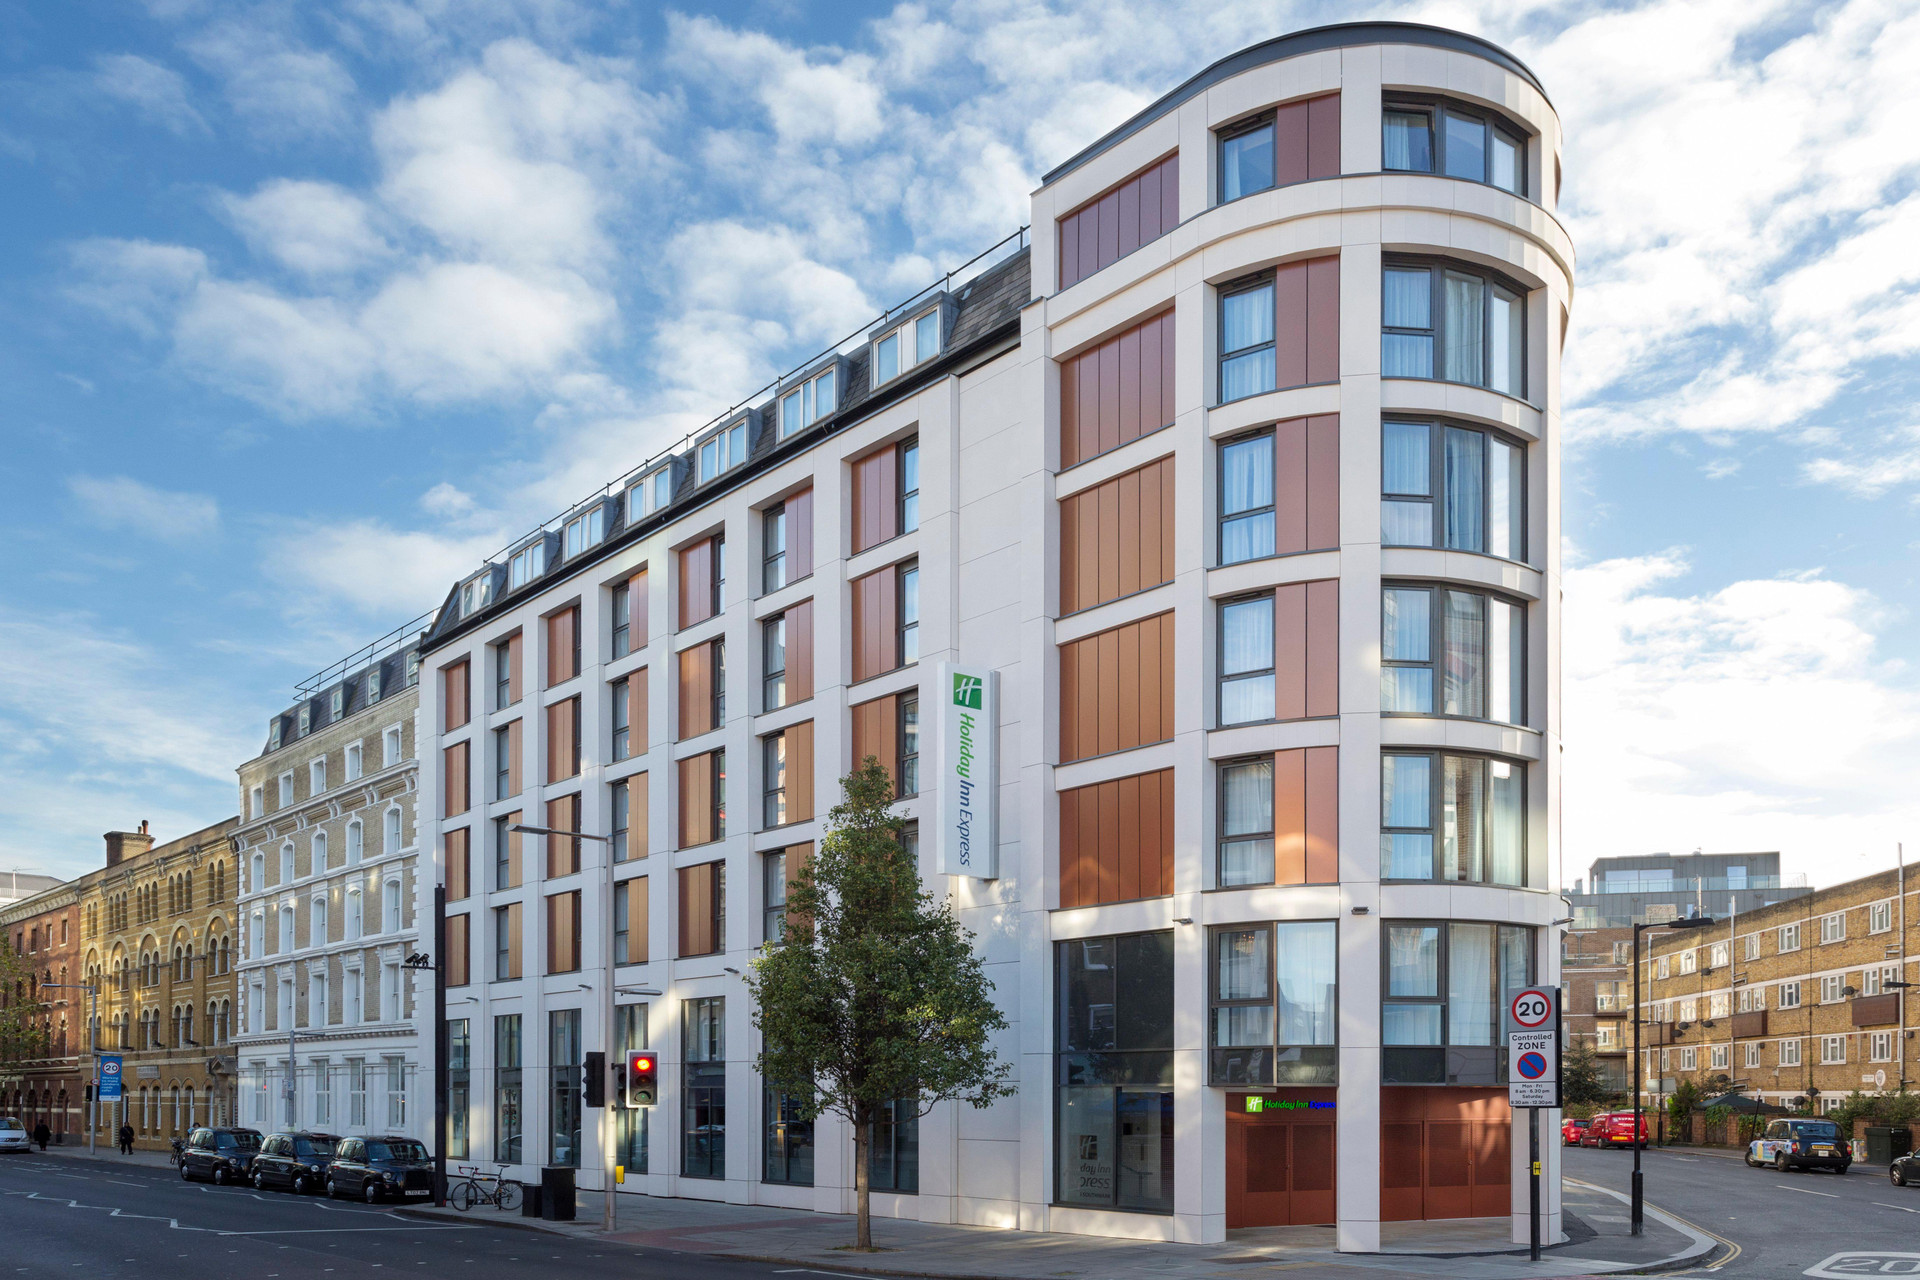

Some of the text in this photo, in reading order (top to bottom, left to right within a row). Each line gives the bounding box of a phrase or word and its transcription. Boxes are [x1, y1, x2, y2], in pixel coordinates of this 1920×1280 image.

[956, 712, 974, 866] Holiday Inn Express
[1518, 1000, 1545, 1016] 20
[1512, 1033, 1552, 1041] Controlled
[1518, 1042, 1546, 1050] ZONE
[1264, 1100, 1295, 1110] Holiday
[1296, 1100, 1308, 1108] Inn
[1309, 1100, 1336, 1110] Express
[1097, 1162, 1111, 1173] Inn
[1828, 1258, 1920, 1273] 20
